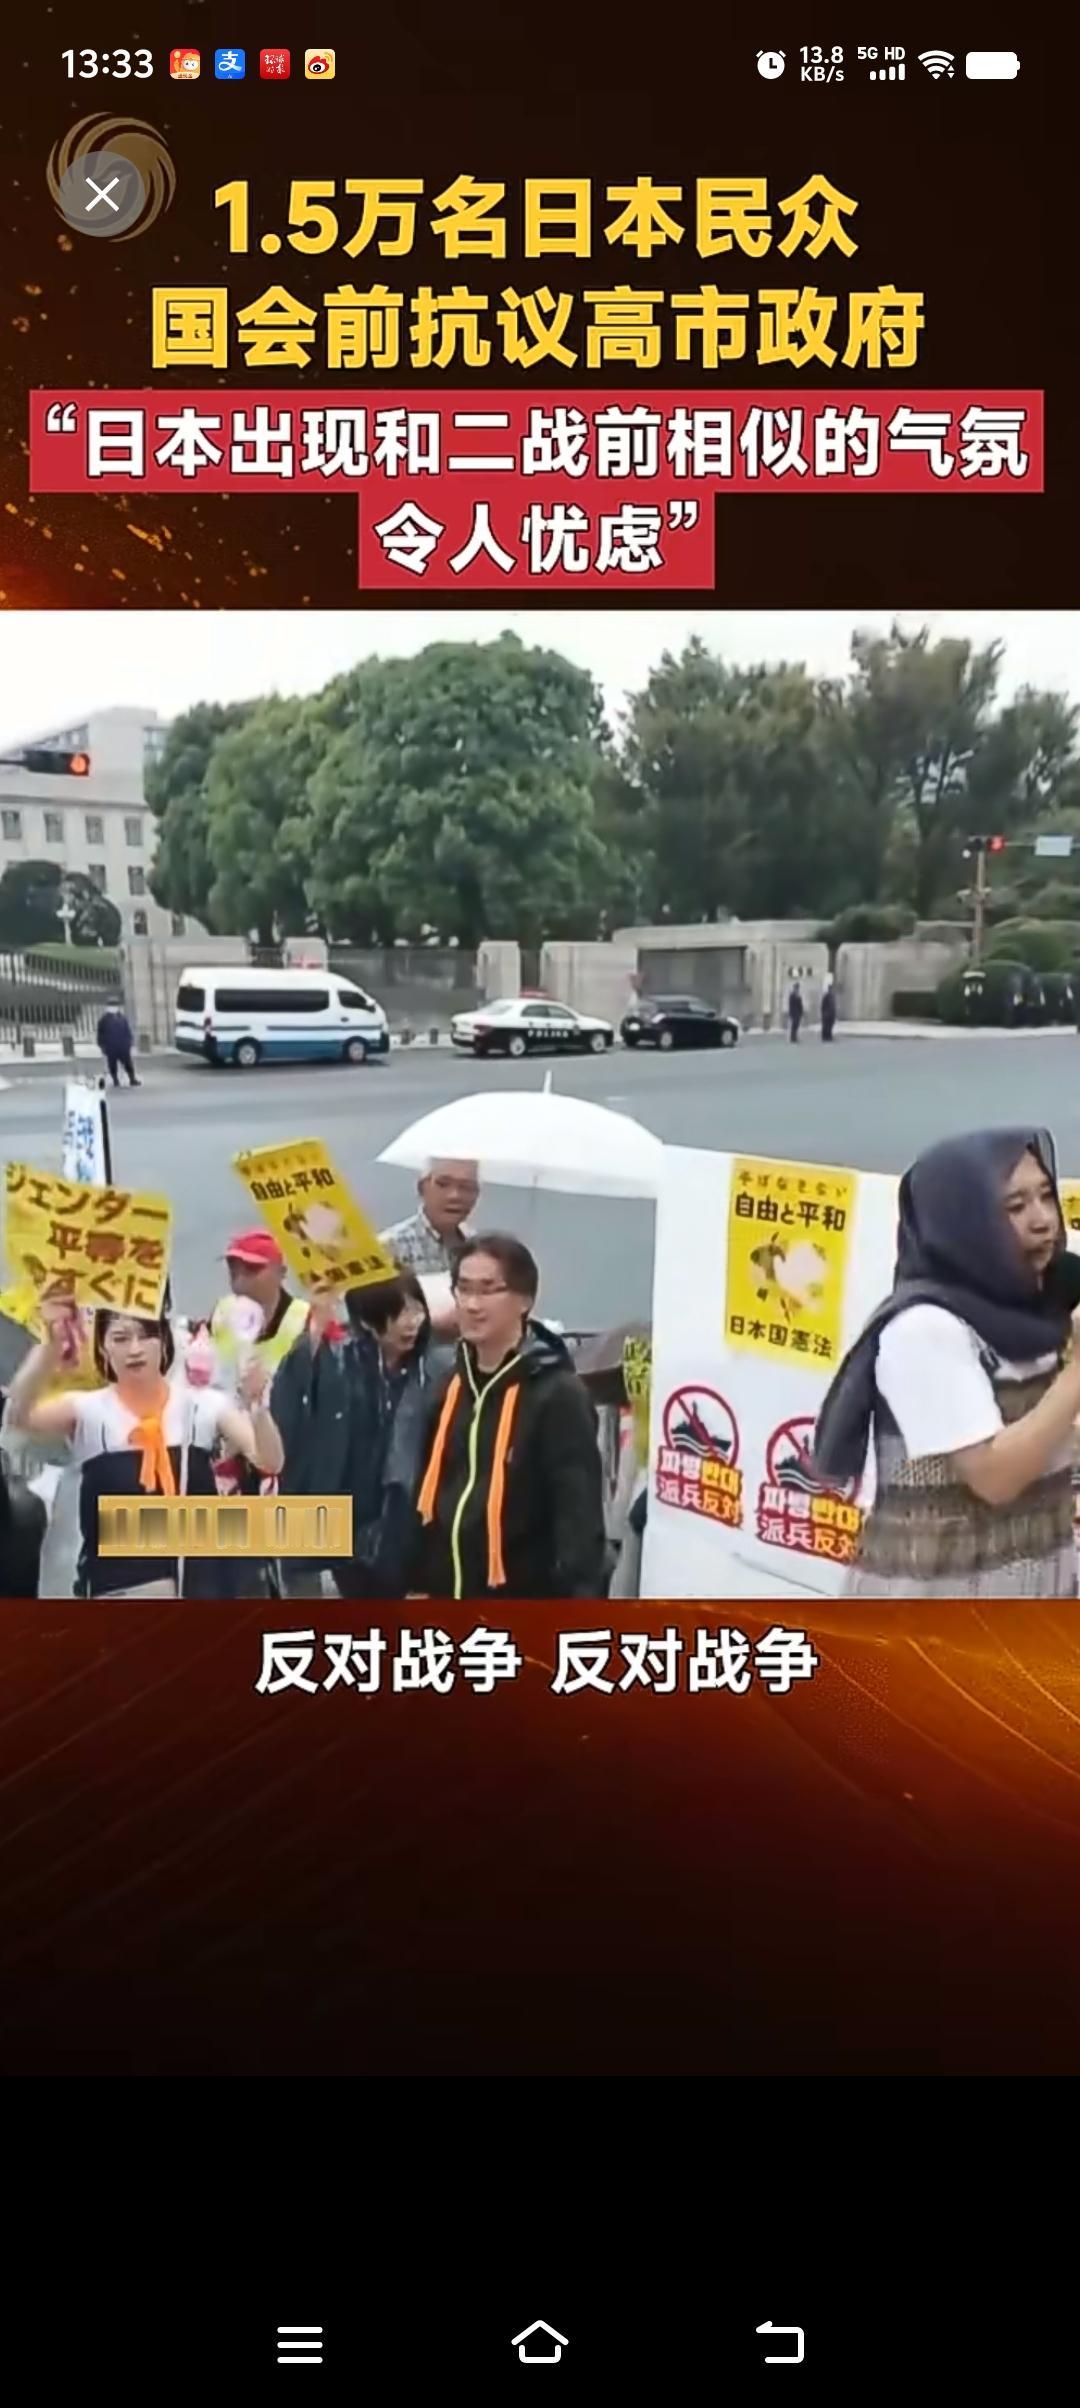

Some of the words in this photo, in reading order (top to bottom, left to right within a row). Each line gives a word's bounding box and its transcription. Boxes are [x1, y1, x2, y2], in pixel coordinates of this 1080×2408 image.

[735, 1191, 846, 1232] 自由と平和
[730, 1315, 832, 1358] 日本国憲法
